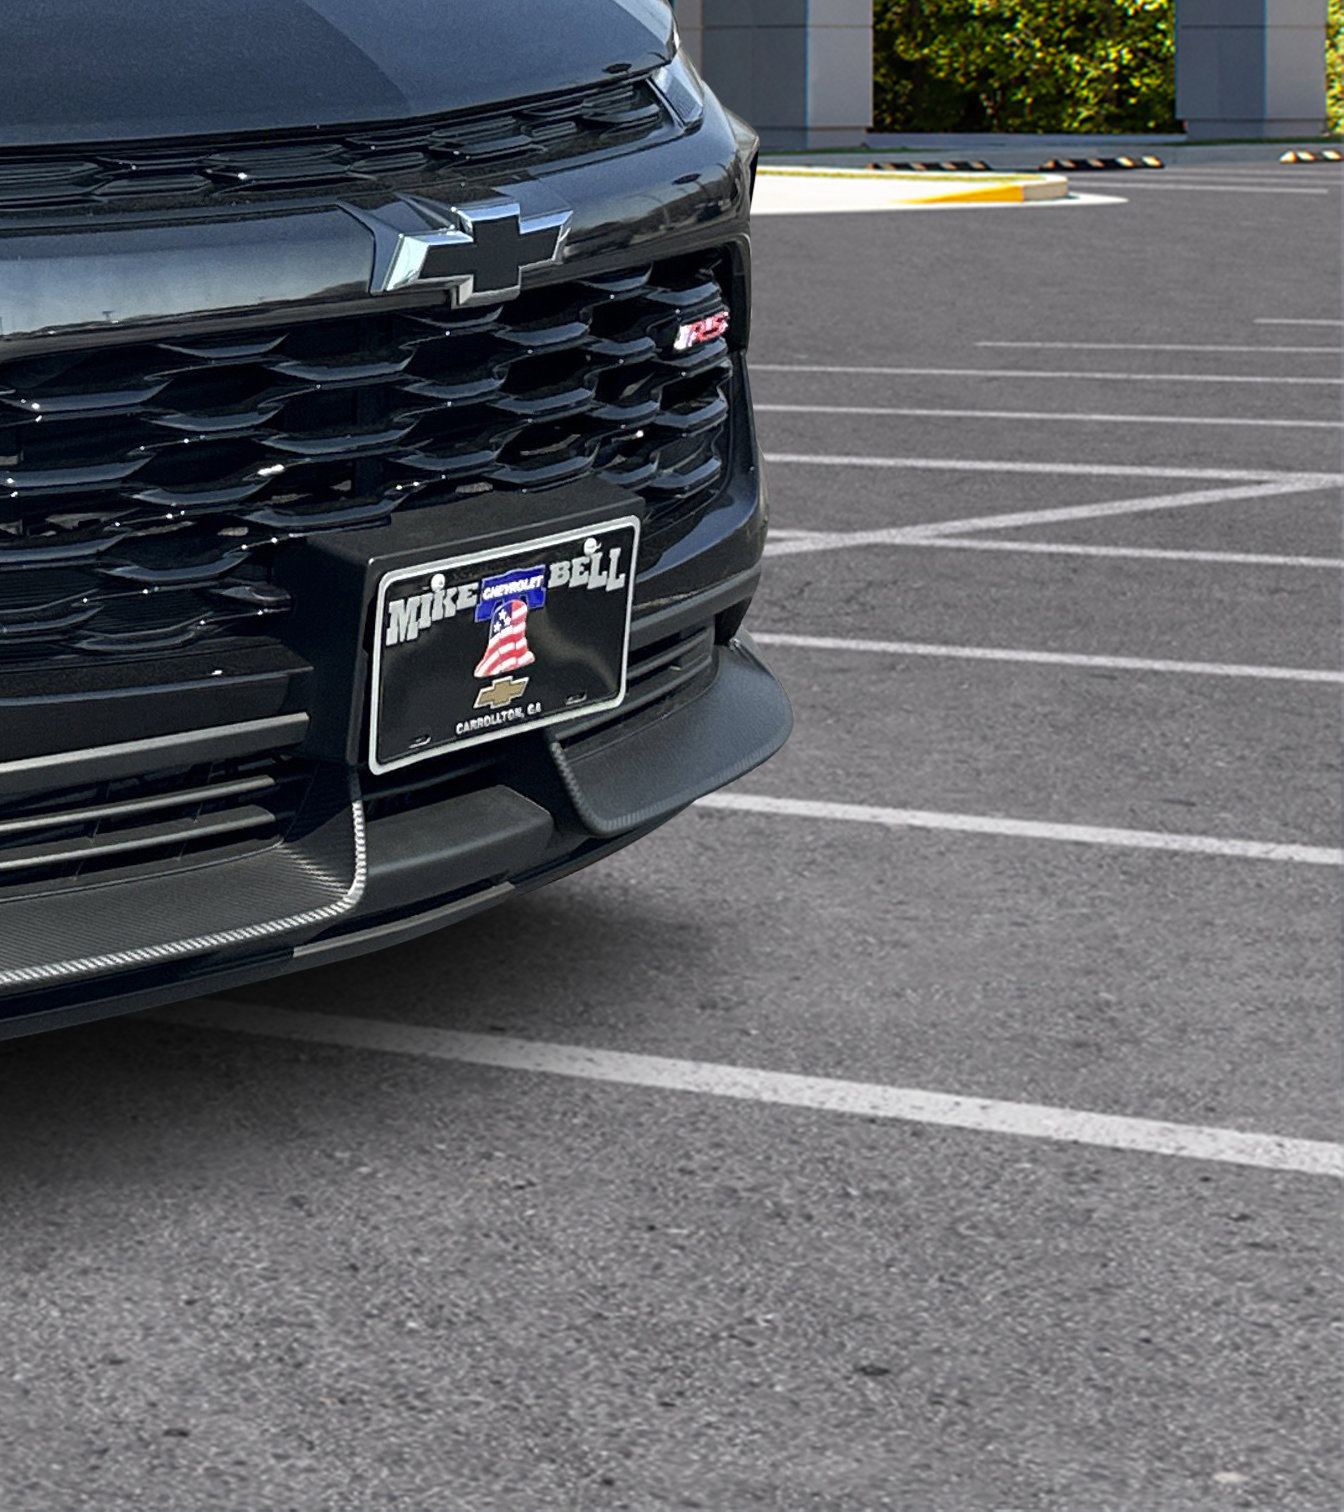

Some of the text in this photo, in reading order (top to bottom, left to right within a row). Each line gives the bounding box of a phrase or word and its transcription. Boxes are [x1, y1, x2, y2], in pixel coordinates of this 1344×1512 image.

[386, 546, 626, 646] MIKE BELL
[482, 575, 544, 600] CHEVROLET
[456, 702, 542, 734] CARROLLTON, GA
